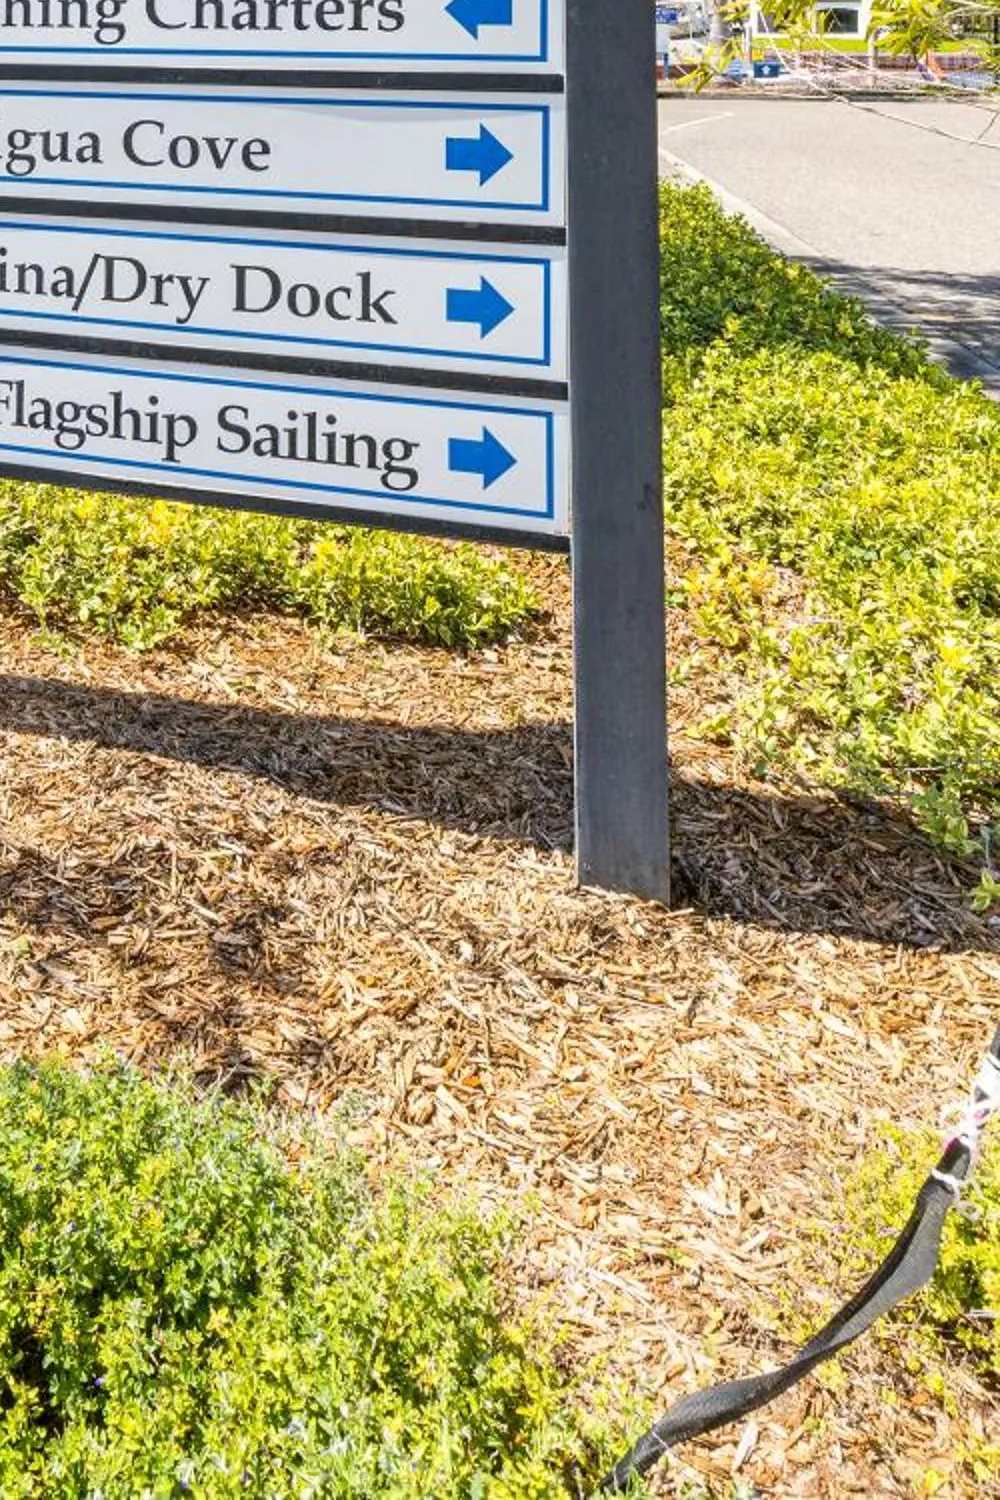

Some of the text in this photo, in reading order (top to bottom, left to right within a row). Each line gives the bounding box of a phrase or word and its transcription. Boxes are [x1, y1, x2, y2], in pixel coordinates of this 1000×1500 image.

[122, 119, 272, 172] Cove
[230, 264, 399, 325] Dock
[215, 403, 421, 491] Sailing
